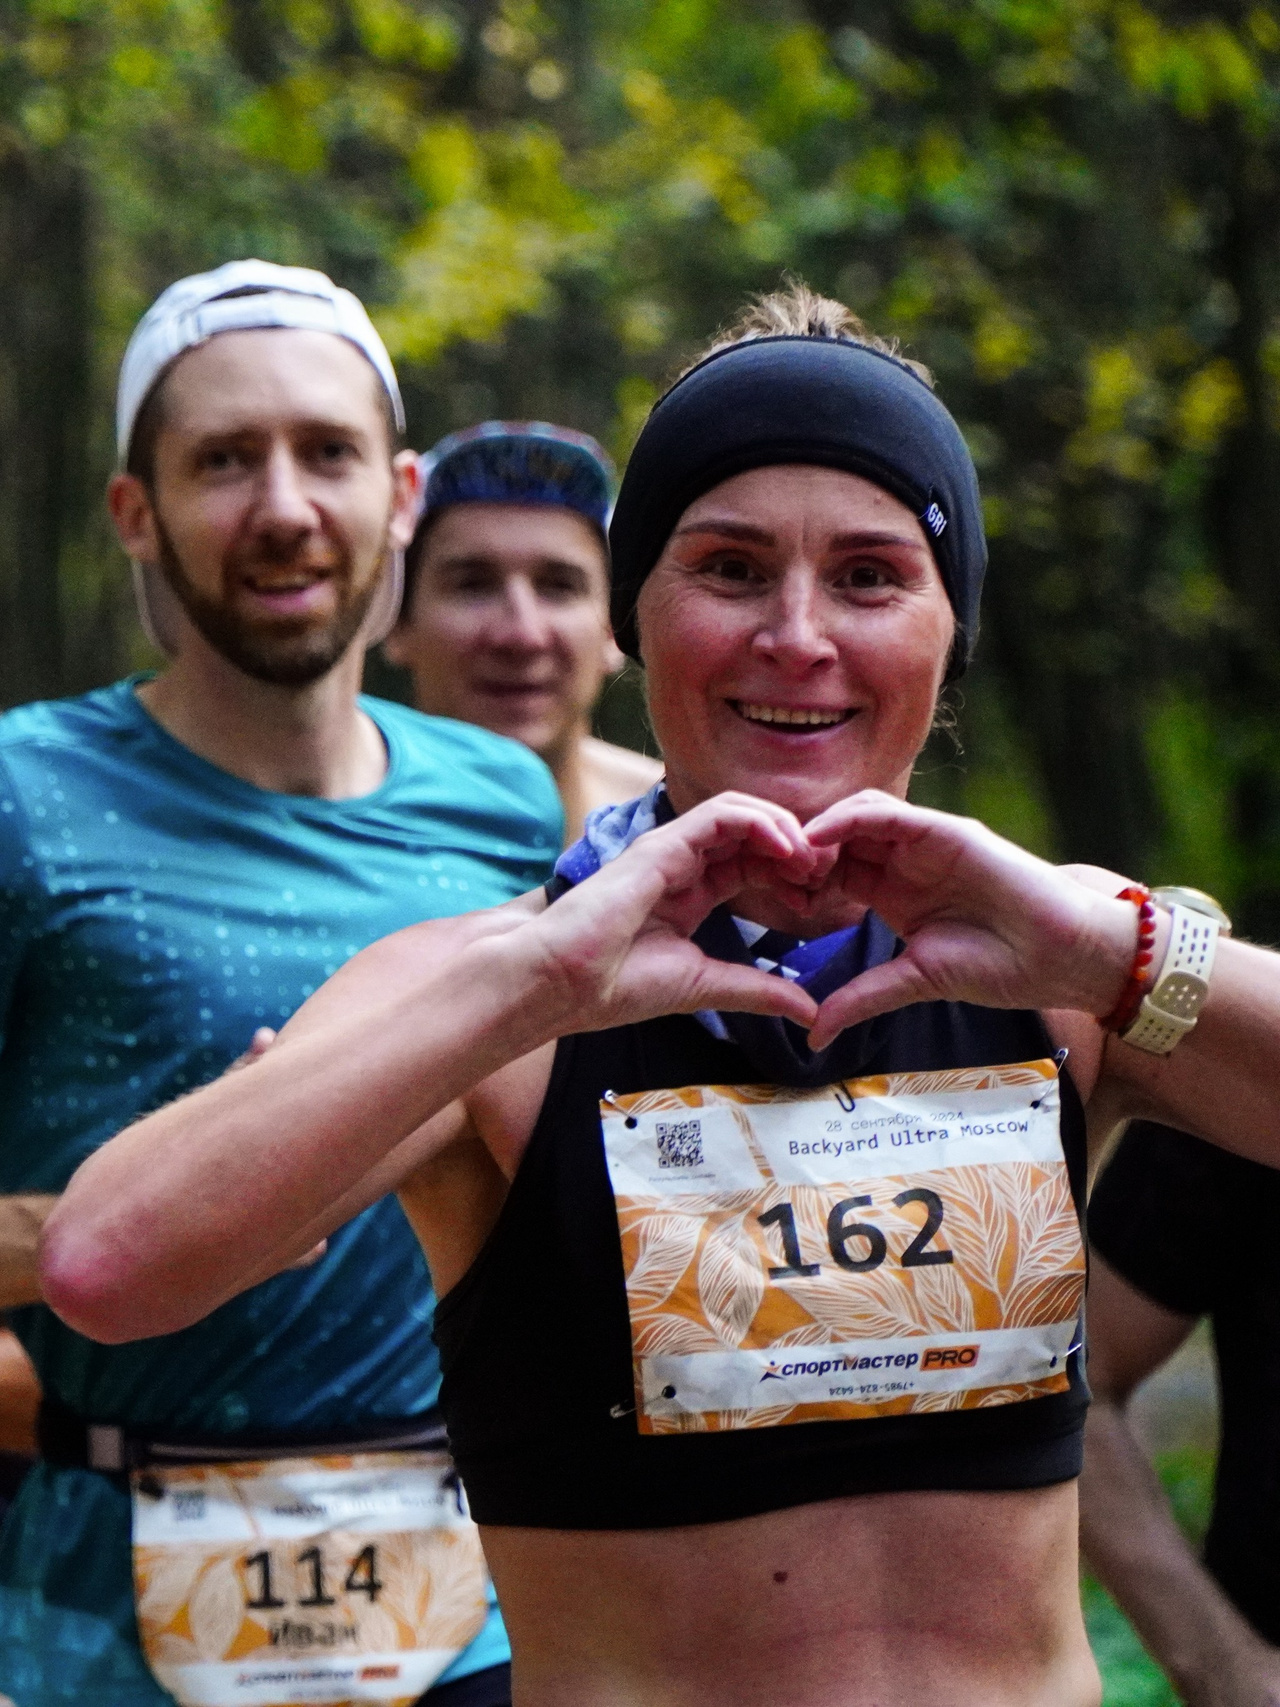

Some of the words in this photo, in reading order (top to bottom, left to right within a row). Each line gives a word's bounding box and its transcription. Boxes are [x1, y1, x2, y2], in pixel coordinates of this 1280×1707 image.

[927, 502, 948, 537] GRI
[788, 1134, 879, 1157] Backyard
[891, 1127, 949, 1147] Ultra
[960, 1120, 1029, 1137] Moscow
[824, 1120, 842, 1132] 28
[756, 1187, 955, 1280] 162
[923, 1349, 976, 1368] PRO
[246, 1542, 383, 1610] 114
